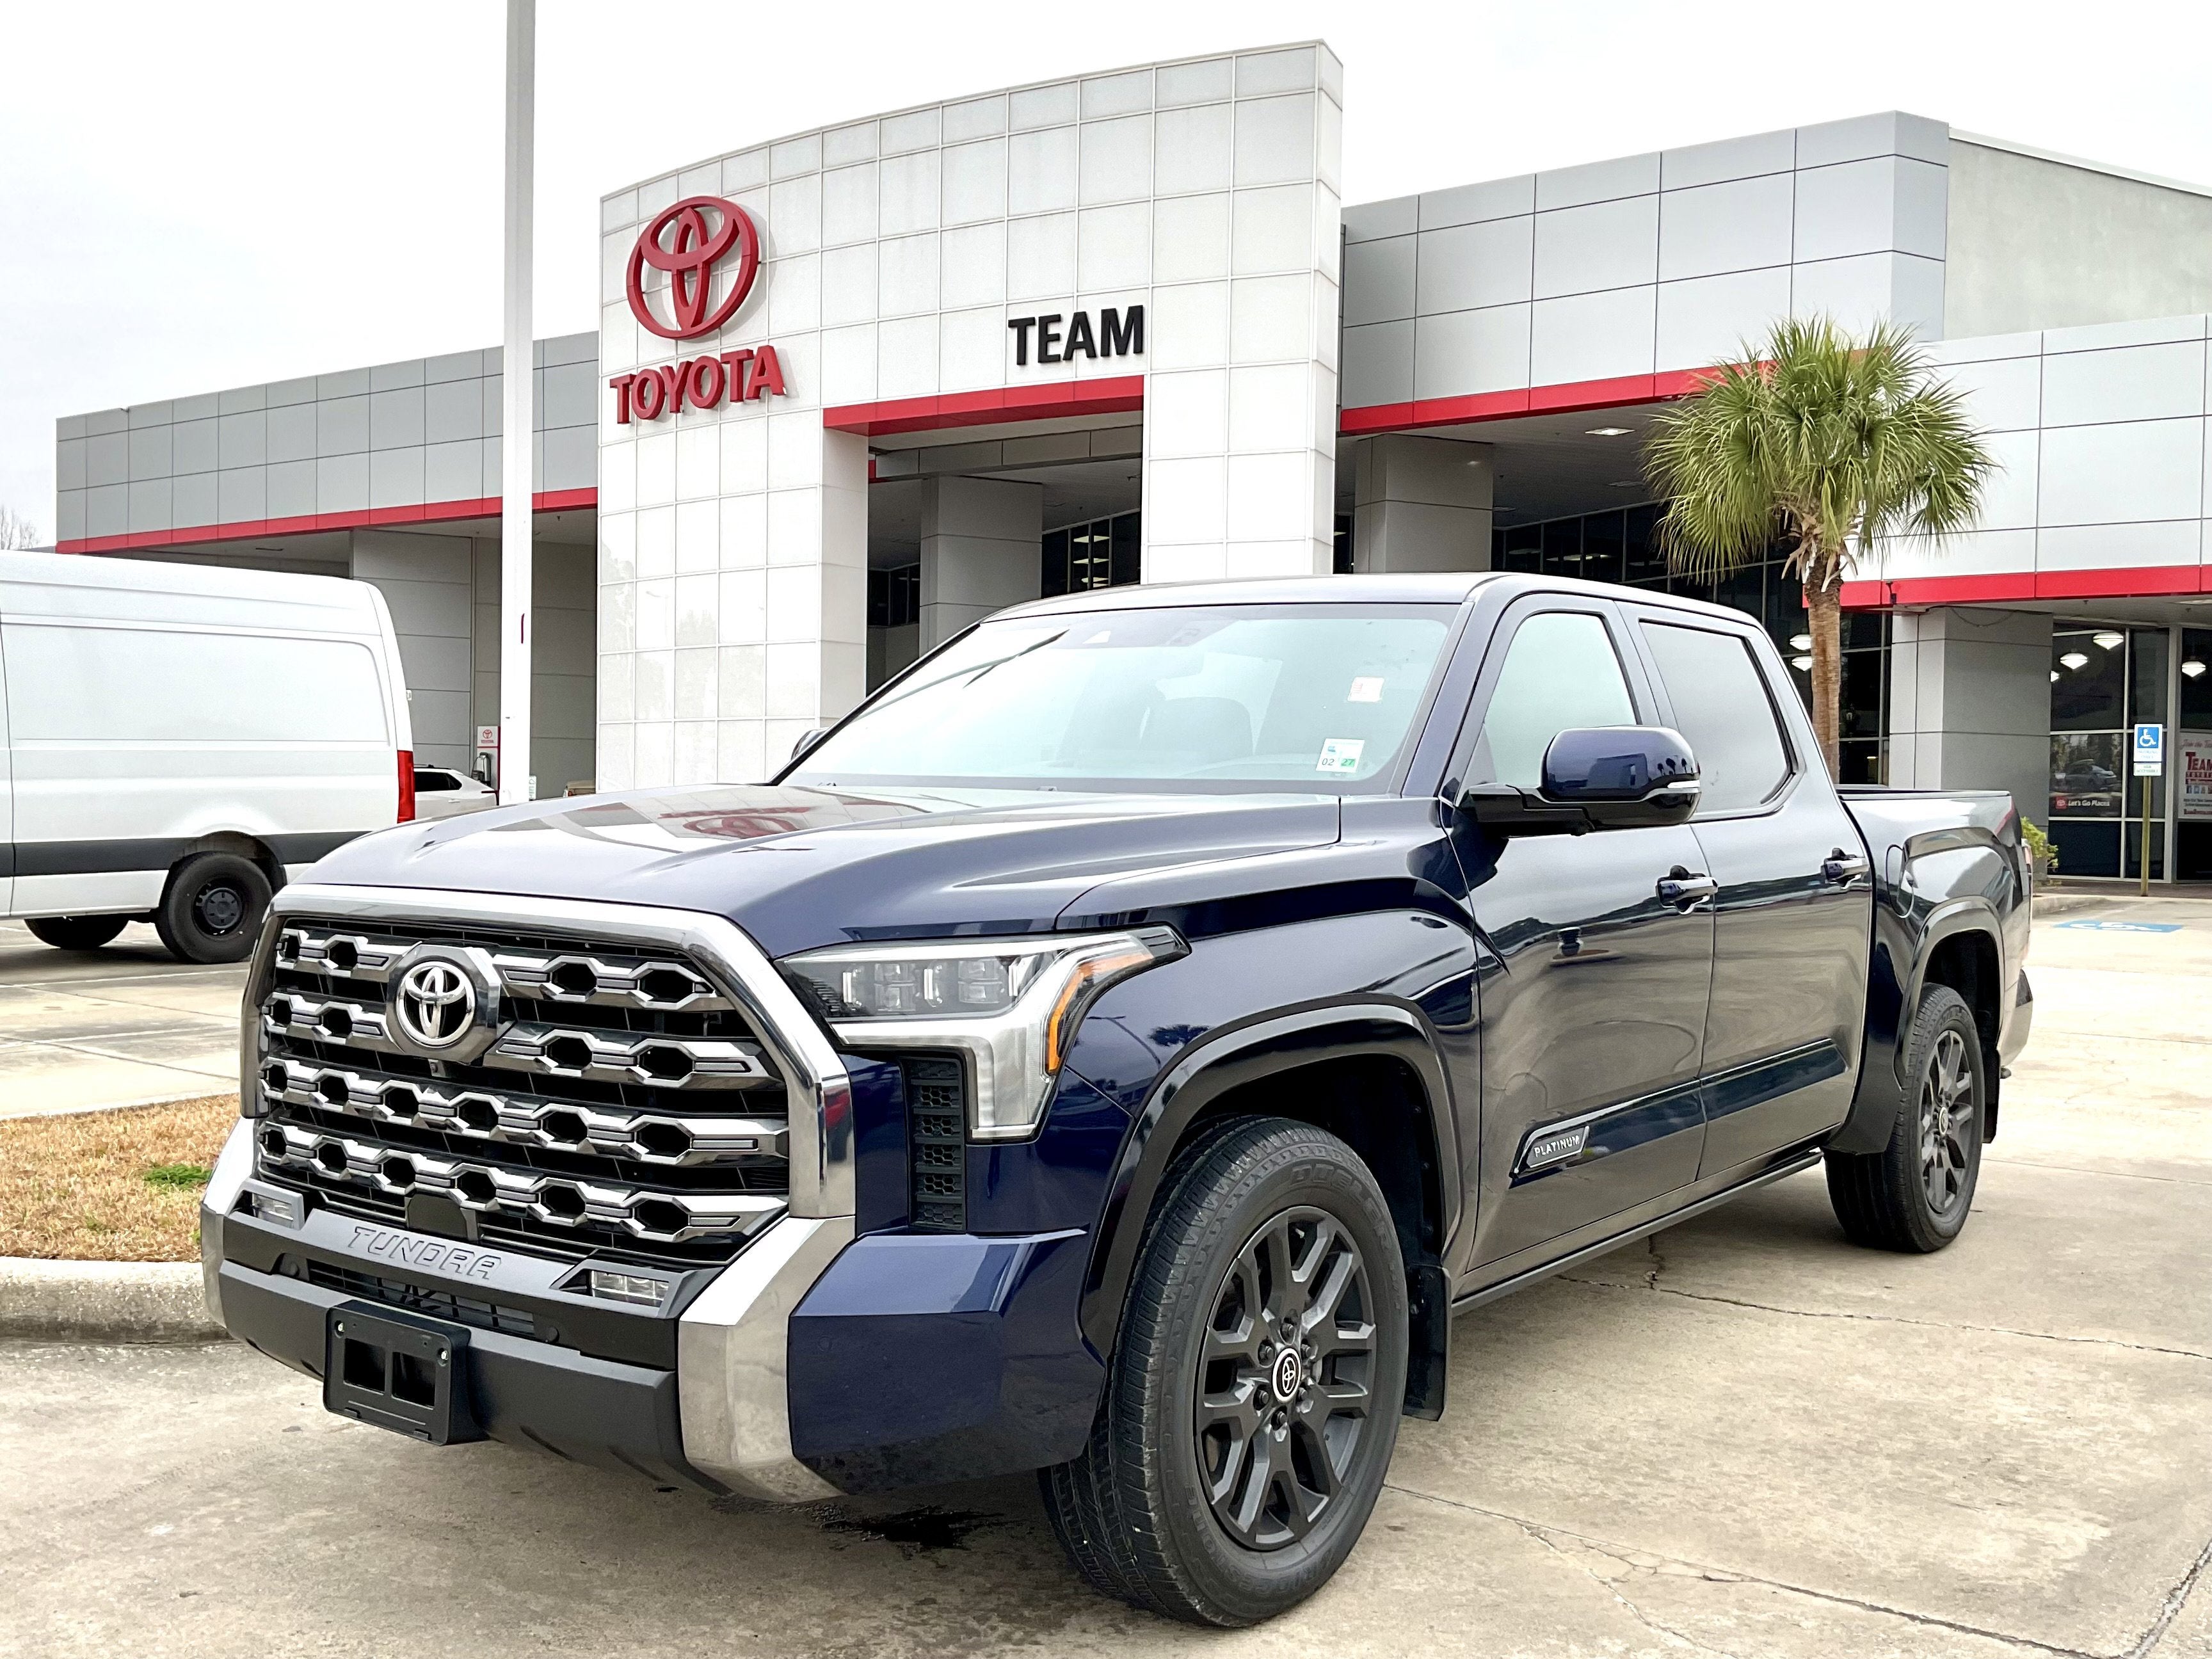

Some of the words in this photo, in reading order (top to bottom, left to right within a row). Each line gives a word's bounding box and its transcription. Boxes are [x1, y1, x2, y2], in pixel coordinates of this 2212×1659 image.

[1007, 305, 1144, 366] TEAM
[610, 344, 787, 424] TOYOTA
[1322, 758, 1334, 766] 02
[1341, 758, 1356, 767] 27
[1534, 1135, 1580, 1157] PLATINUM
[348, 1226, 502, 1280] TUNDRA
